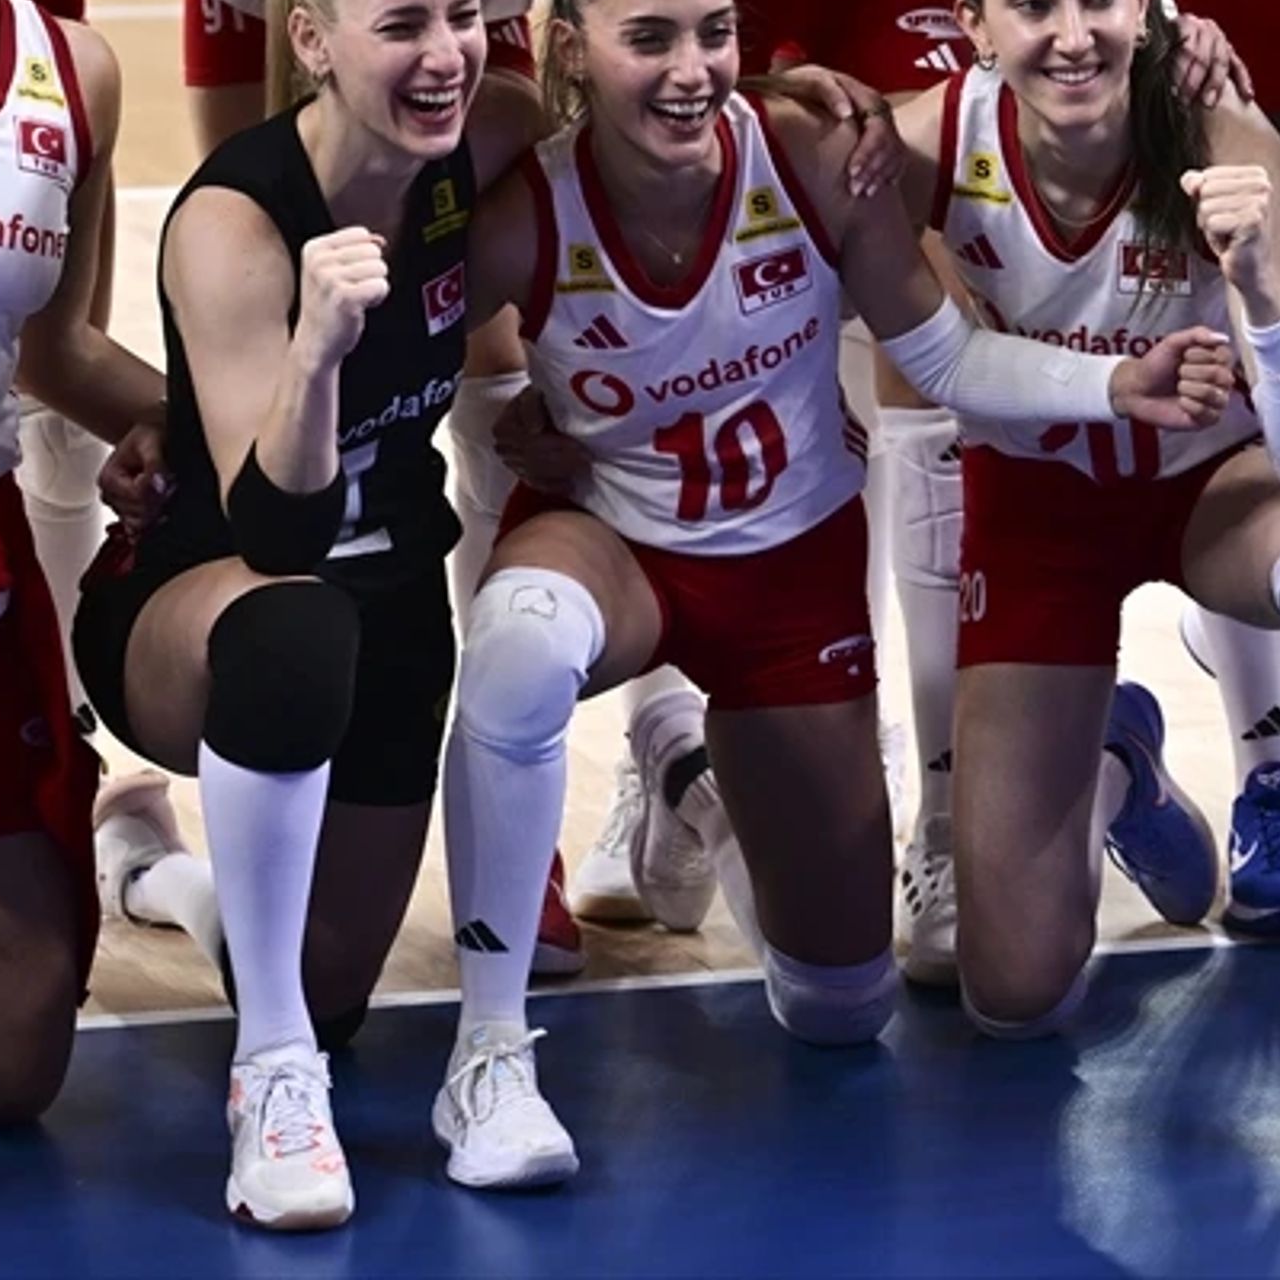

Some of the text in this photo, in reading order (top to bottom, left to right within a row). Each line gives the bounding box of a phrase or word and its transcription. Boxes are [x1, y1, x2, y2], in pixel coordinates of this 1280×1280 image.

[30, 63, 46, 82] S
[974, 158, 991, 180] S
[751, 193, 771, 215] S
[575, 249, 594, 271] S
[759, 284, 796, 304] TUR
[645, 316, 820, 404] vodafone
[652, 398, 789, 523] 10
